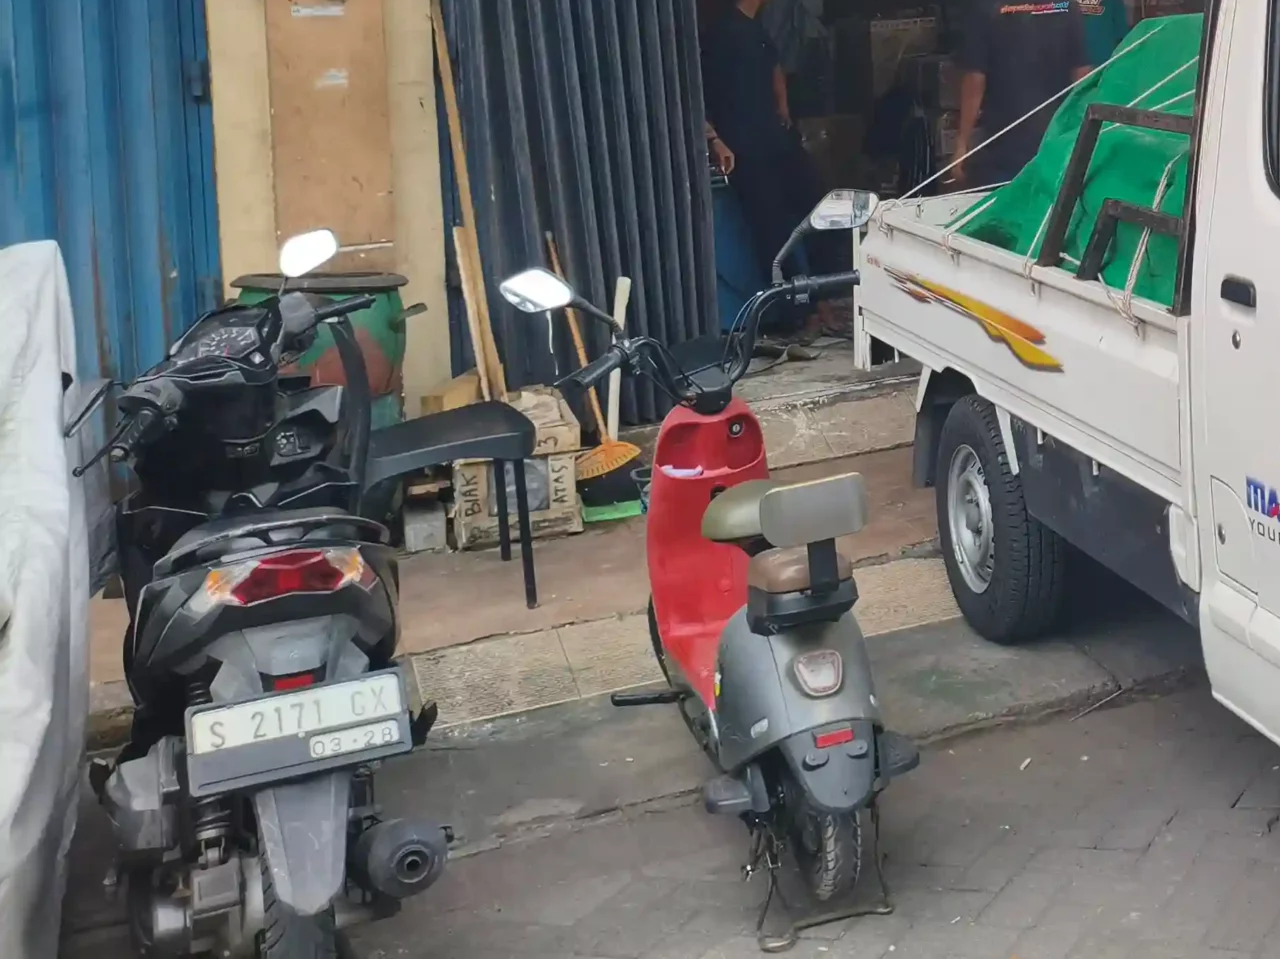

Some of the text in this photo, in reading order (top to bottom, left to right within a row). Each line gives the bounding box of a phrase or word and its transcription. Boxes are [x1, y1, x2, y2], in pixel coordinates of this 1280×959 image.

[461, 472, 482, 518] BIAK
[209, 722, 226, 748] S
[250, 698, 324, 740] 2171
